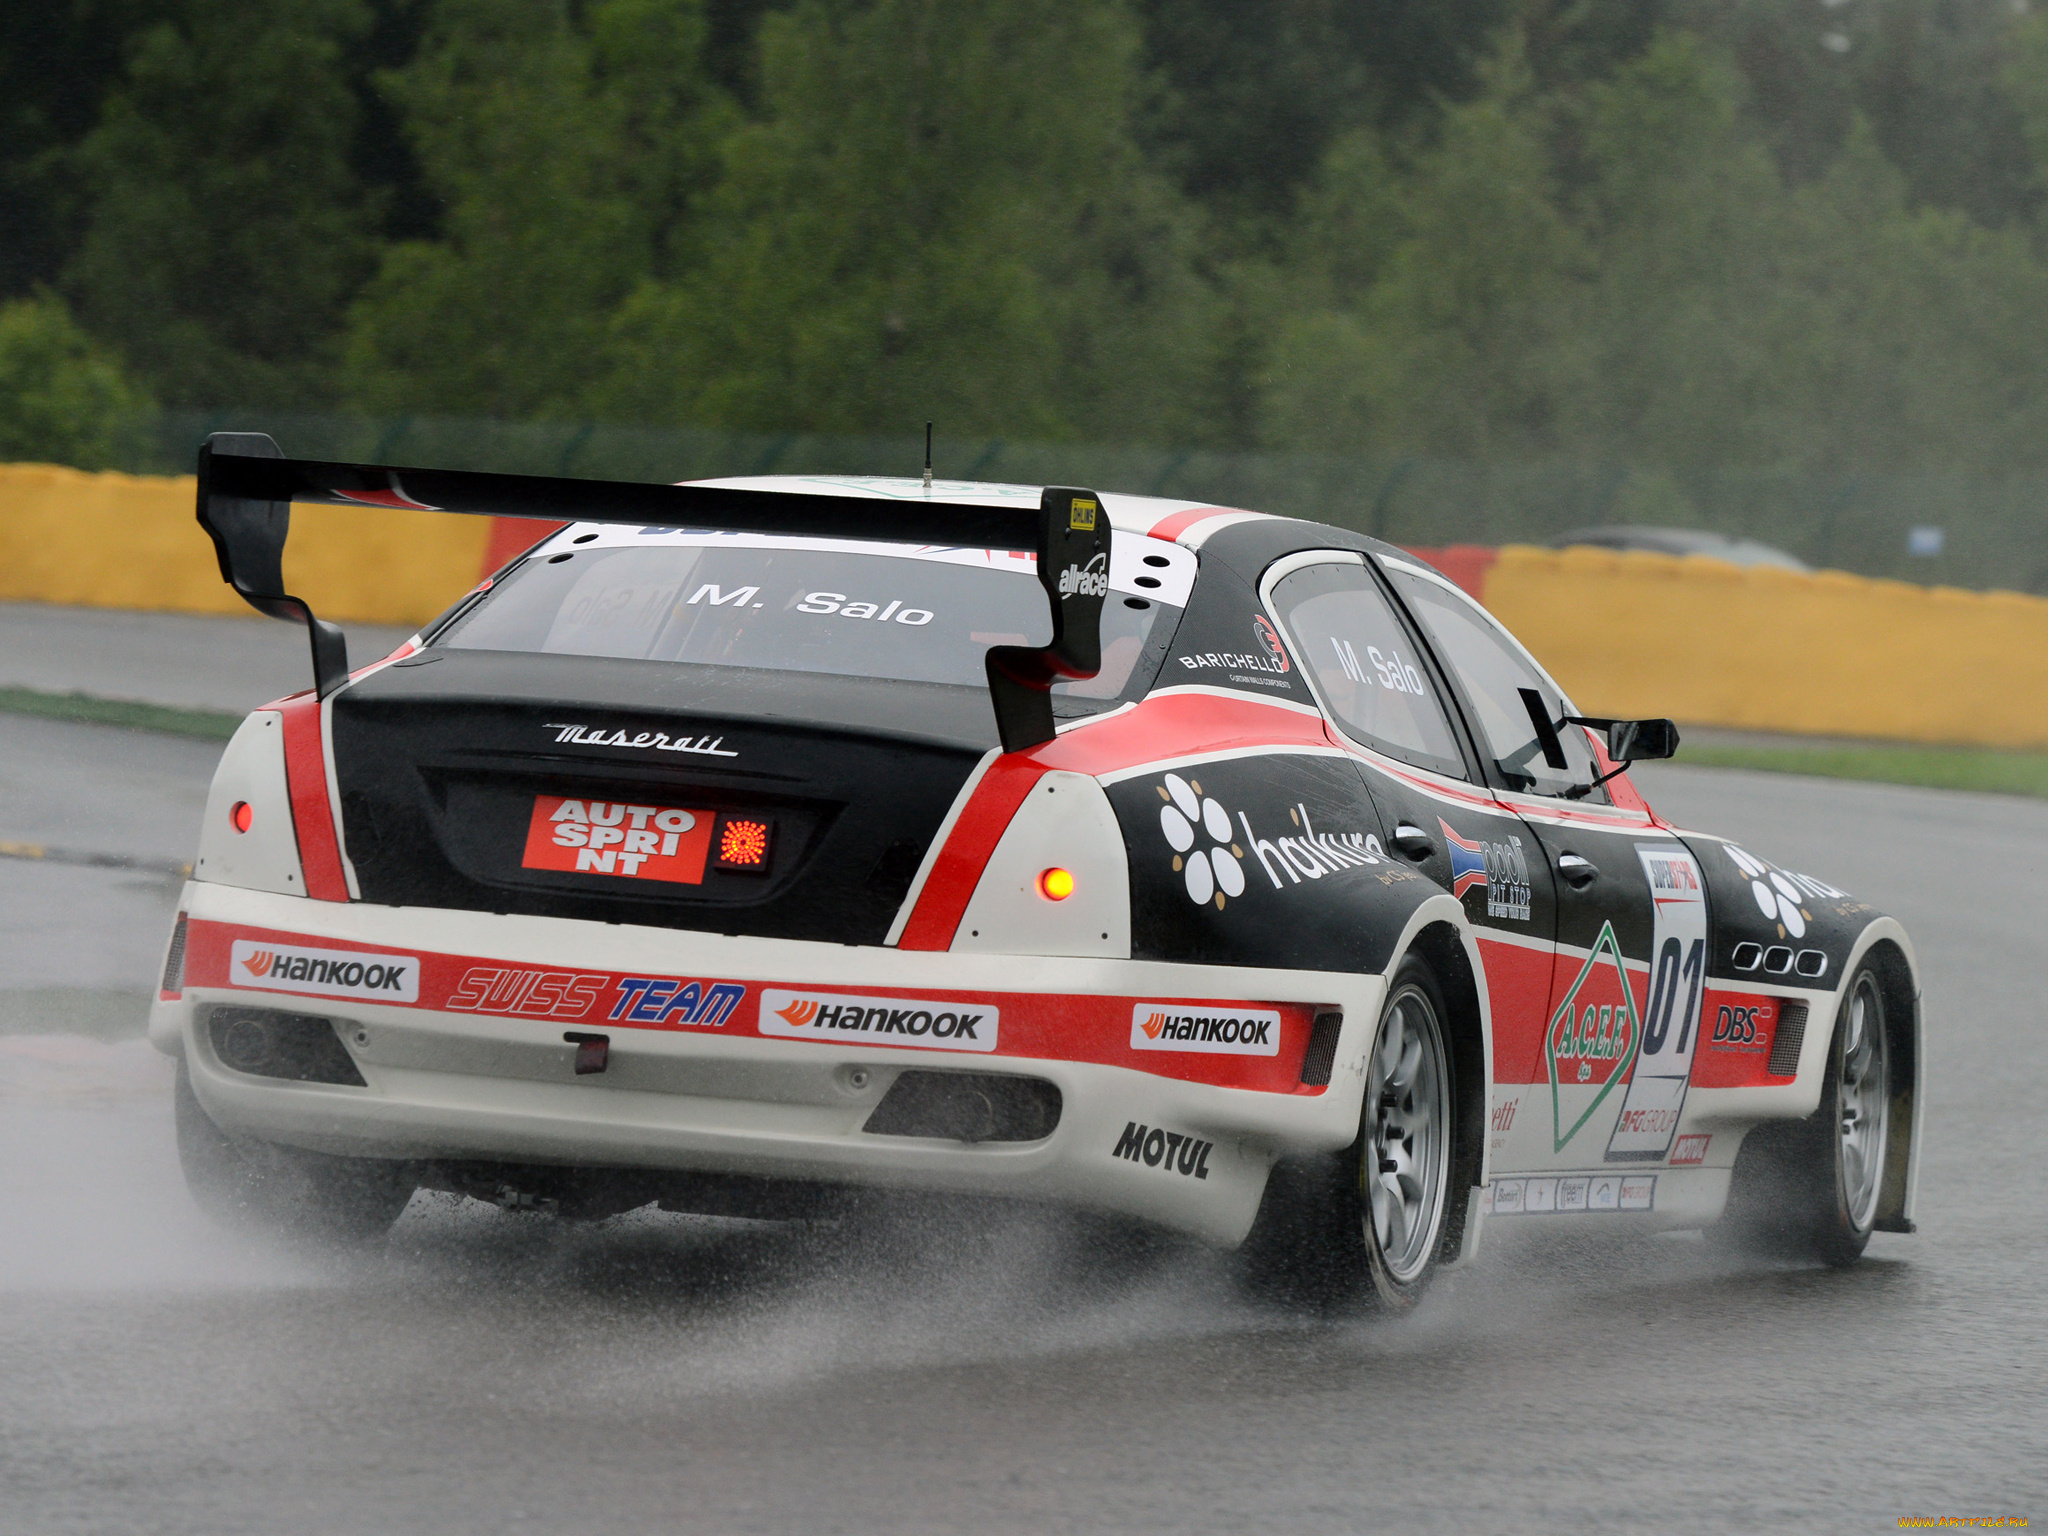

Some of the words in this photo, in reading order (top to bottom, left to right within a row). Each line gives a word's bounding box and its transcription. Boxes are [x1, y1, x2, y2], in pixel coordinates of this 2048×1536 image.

[1060, 563, 1108, 598] allrace
[686, 584, 764, 609] M.
[796, 592, 934, 626] Salo
[1179, 653, 1285, 674] BARICHELLO
[1330, 637, 1372, 685] M.
[1367, 646, 1424, 696] Salo
[543, 723, 739, 757] Maserati
[549, 800, 696, 833] AUTO
[552, 823, 680, 857] SPRI
[575, 849, 648, 876] NT
[1491, 883, 1506, 902] PIT
[1509, 885, 1531, 905] STOP
[446, 967, 610, 1017] SWISS
[607, 978, 746, 1027] TEAM
[1643, 937, 1705, 1056] 01
[1712, 1004, 1760, 1045] DBS
[1112, 1121, 1213, 1180] MOTUL
